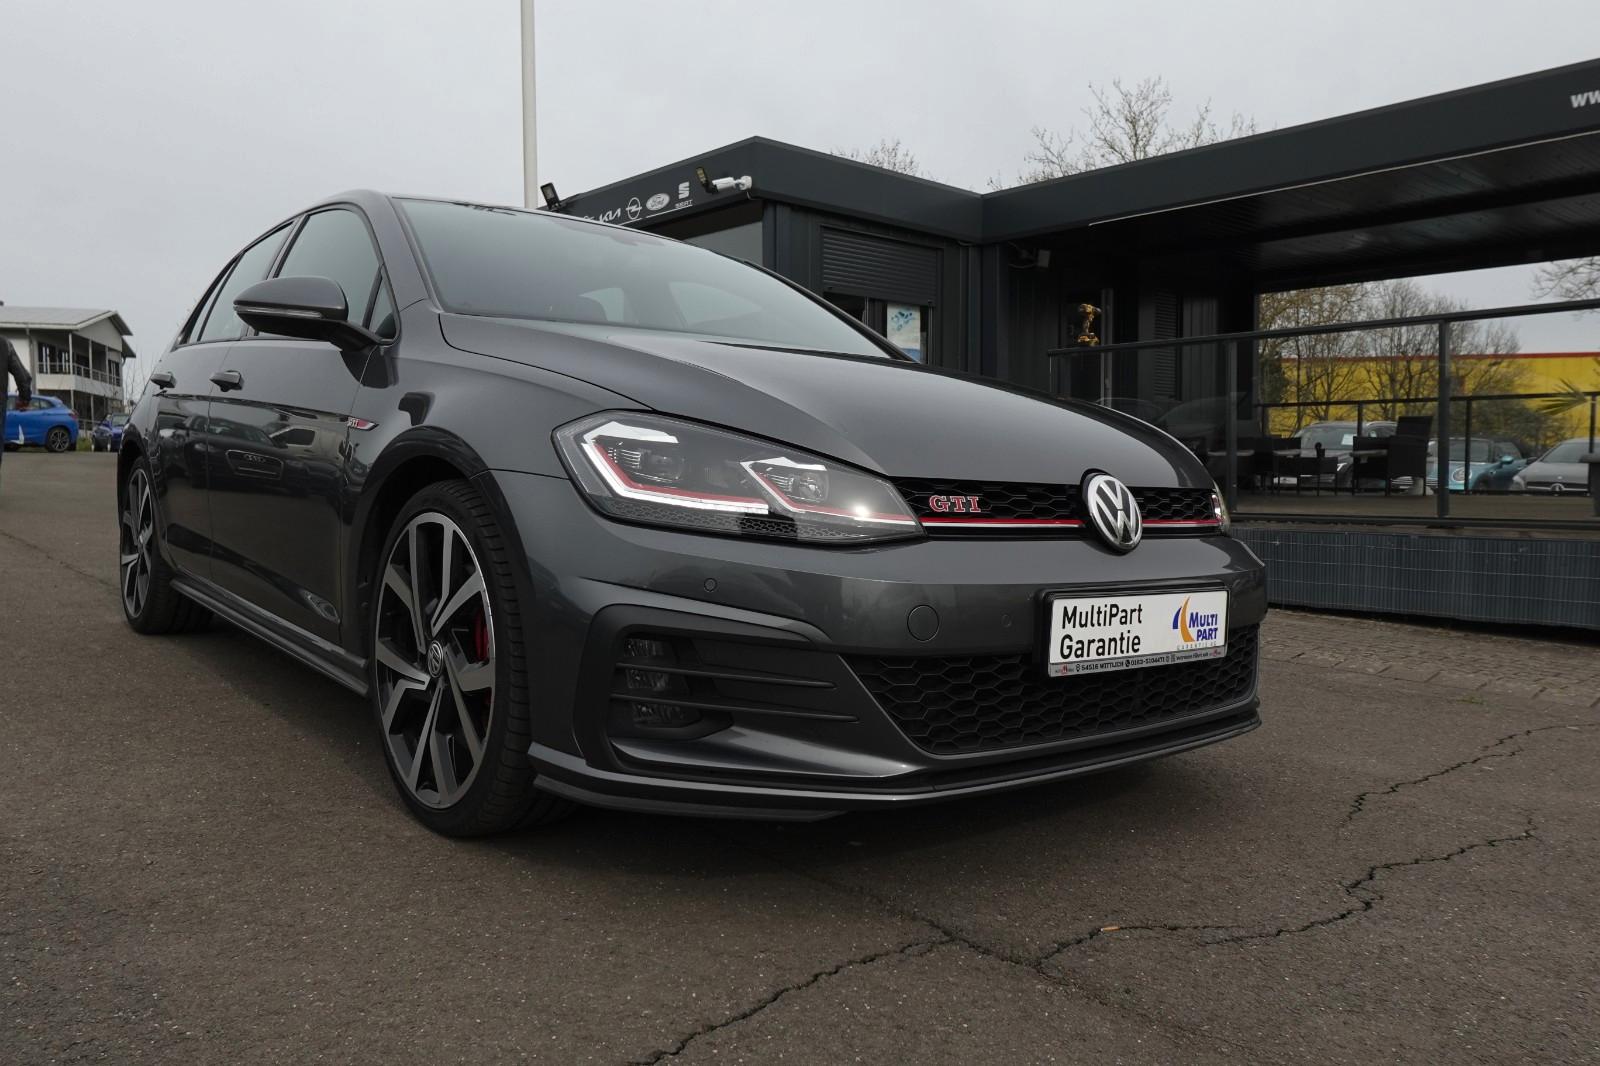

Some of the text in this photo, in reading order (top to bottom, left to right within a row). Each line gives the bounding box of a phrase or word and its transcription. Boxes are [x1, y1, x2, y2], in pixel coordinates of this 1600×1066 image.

[929, 495, 981, 512] GTI
[1062, 604, 1143, 629] MultiPart
[1188, 612, 1218, 628] MULTI
[1196, 627, 1218, 641] PART
[1060, 630, 1141, 659] Garantie
